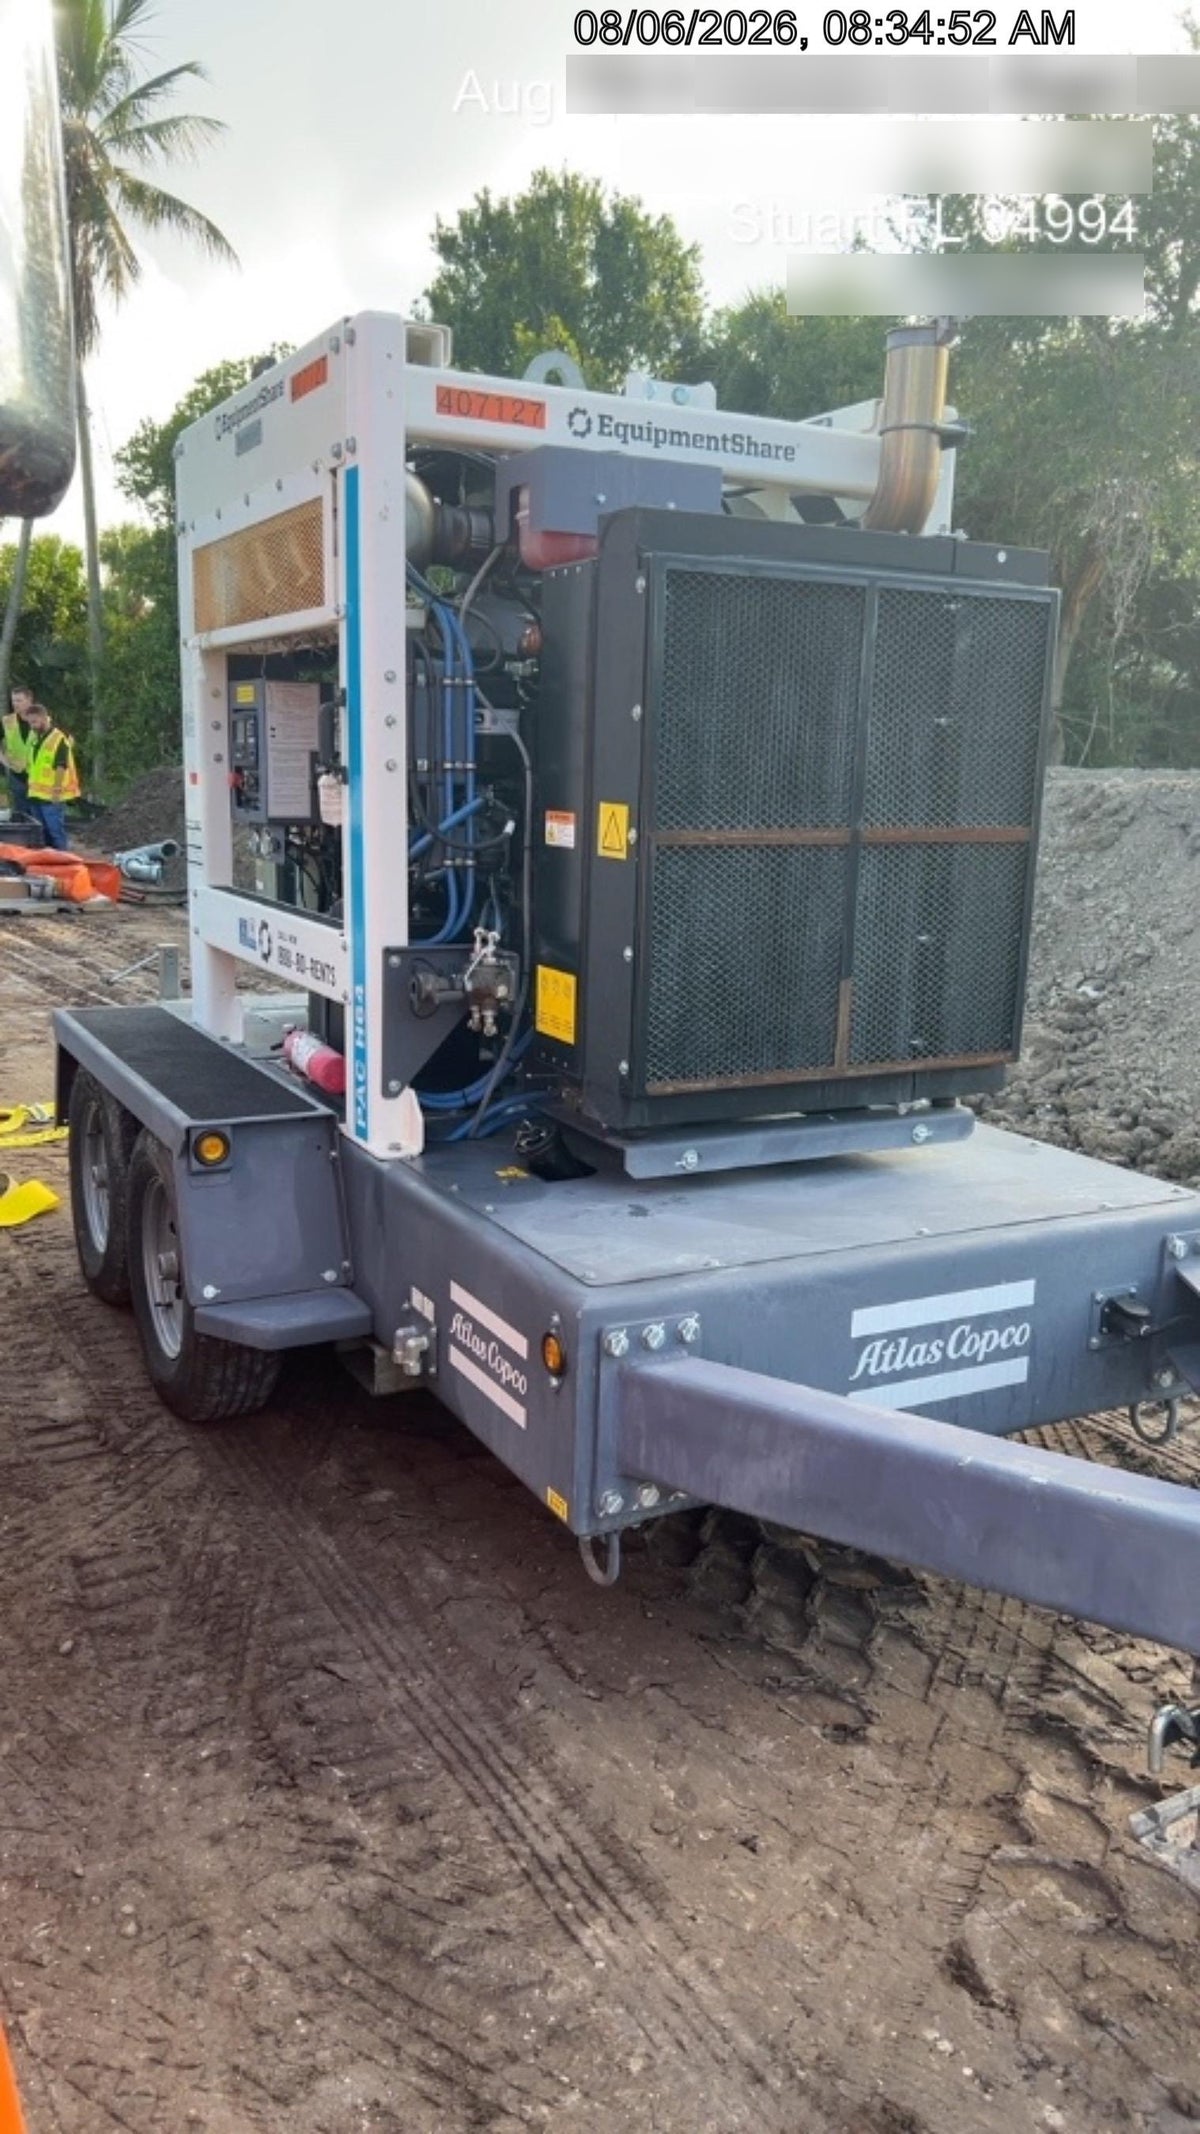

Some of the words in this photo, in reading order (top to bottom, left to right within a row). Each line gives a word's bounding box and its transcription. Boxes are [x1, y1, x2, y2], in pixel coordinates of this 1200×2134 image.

[438, 387, 544, 427] 407127
[597, 413, 796, 462] EquipmentShare
[449, 1312, 487, 1362] Atlas
[488, 1341, 528, 1396] Copco
[848, 1335, 945, 1382] Atlas
[946, 1322, 1031, 1363] Copco
